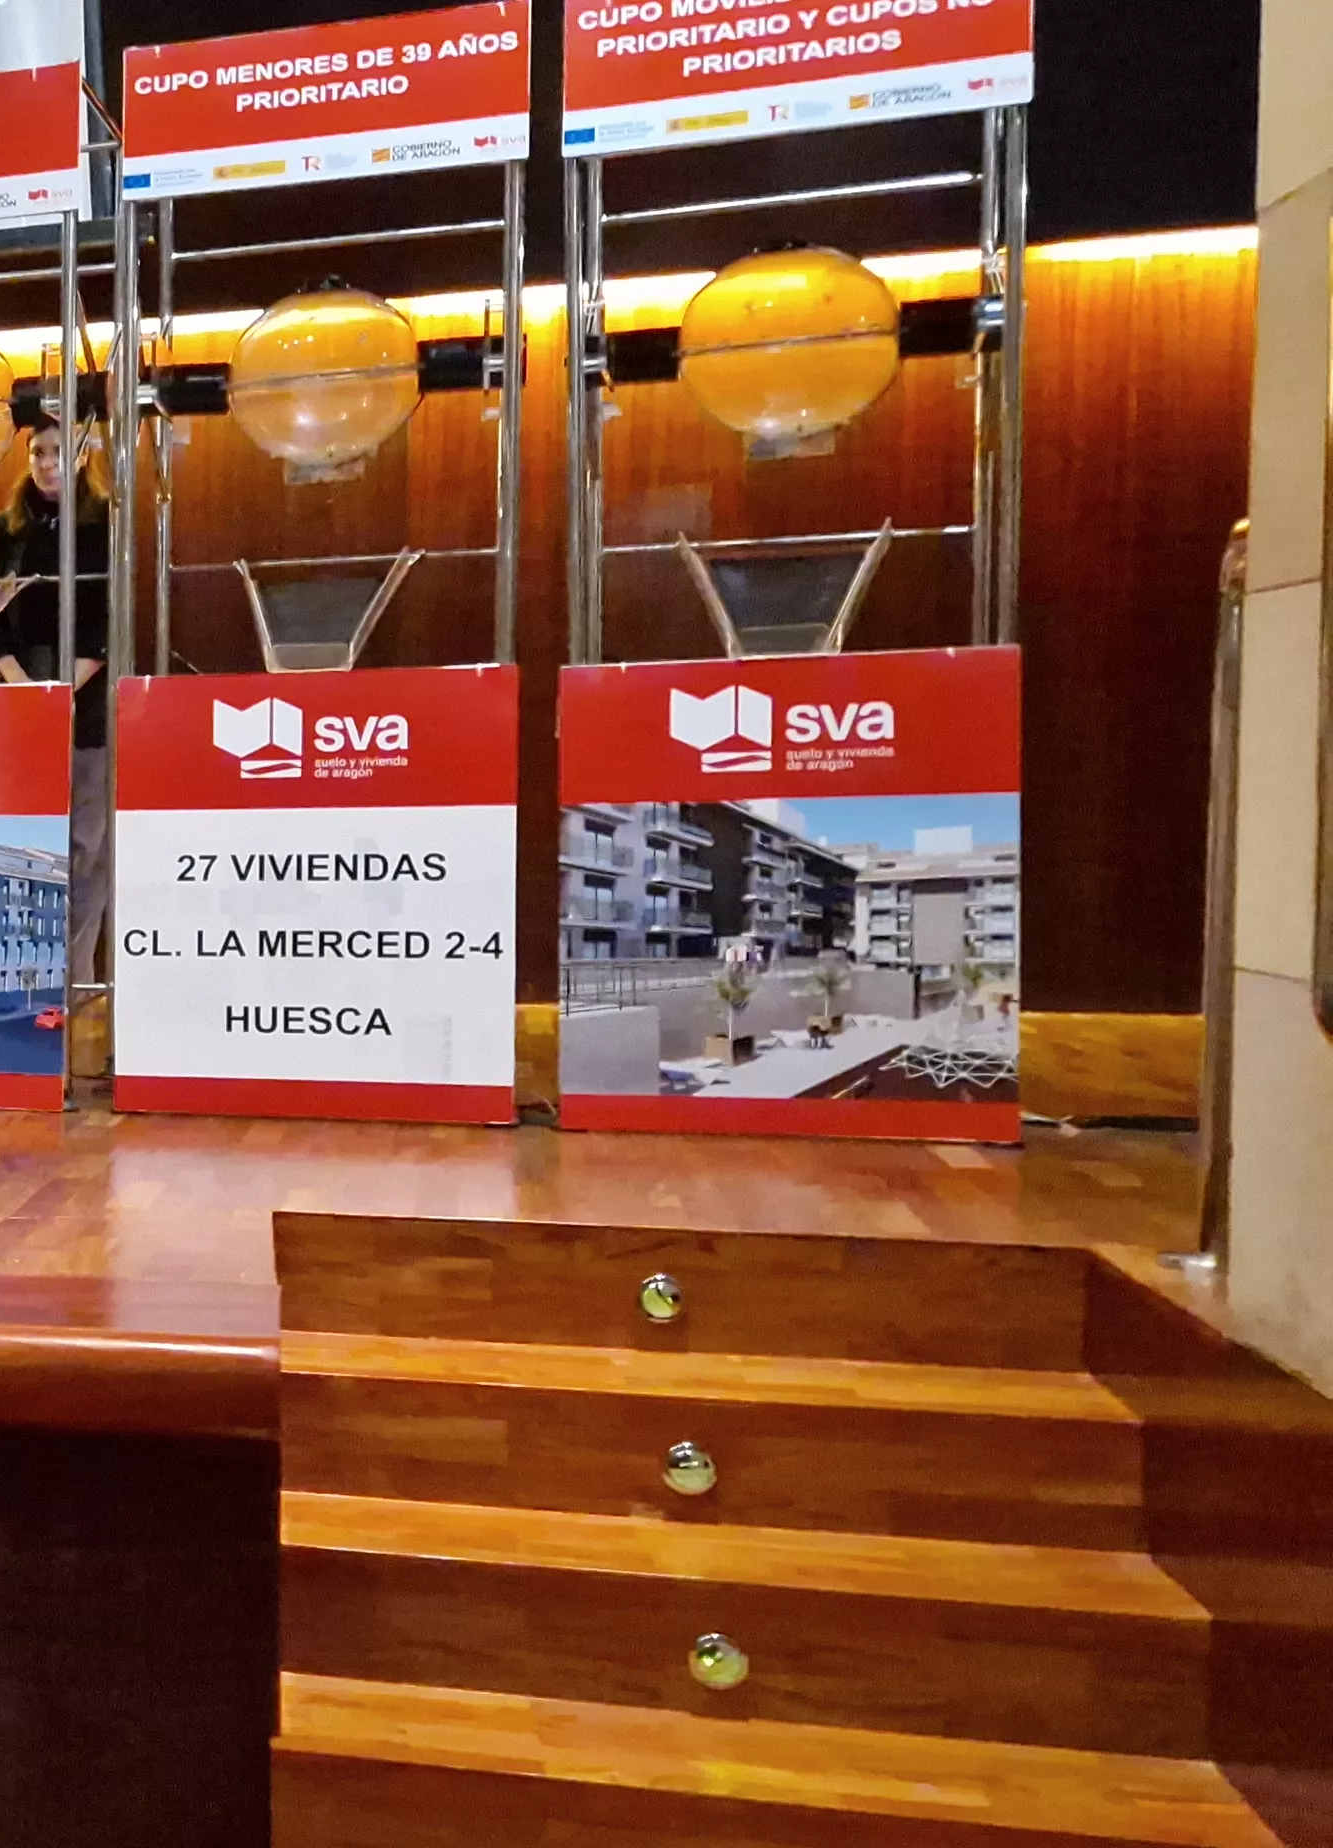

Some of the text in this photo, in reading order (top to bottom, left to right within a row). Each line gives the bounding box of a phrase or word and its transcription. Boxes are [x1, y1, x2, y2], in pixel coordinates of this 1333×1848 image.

[578, 3, 663, 31] CUPO
[596, 15, 791, 58] PRIORITARIO
[797, 9, 821, 30] Y
[826, 0, 939, 27] CUPOS
[134, 31, 519, 95] CUPO MENORES DE 39 AÑOS
[682, 29, 902, 77] PRIORITARIOS
[236, 75, 409, 112] PRIORITARIO
[314, 714, 409, 752] sva
[785, 701, 895, 743] sva
[176, 852, 448, 882] 27 VIVIENDAS
[123, 929, 504, 959] CL. LA MERCED 2-4
[226, 1005, 392, 1036] HUESCA
